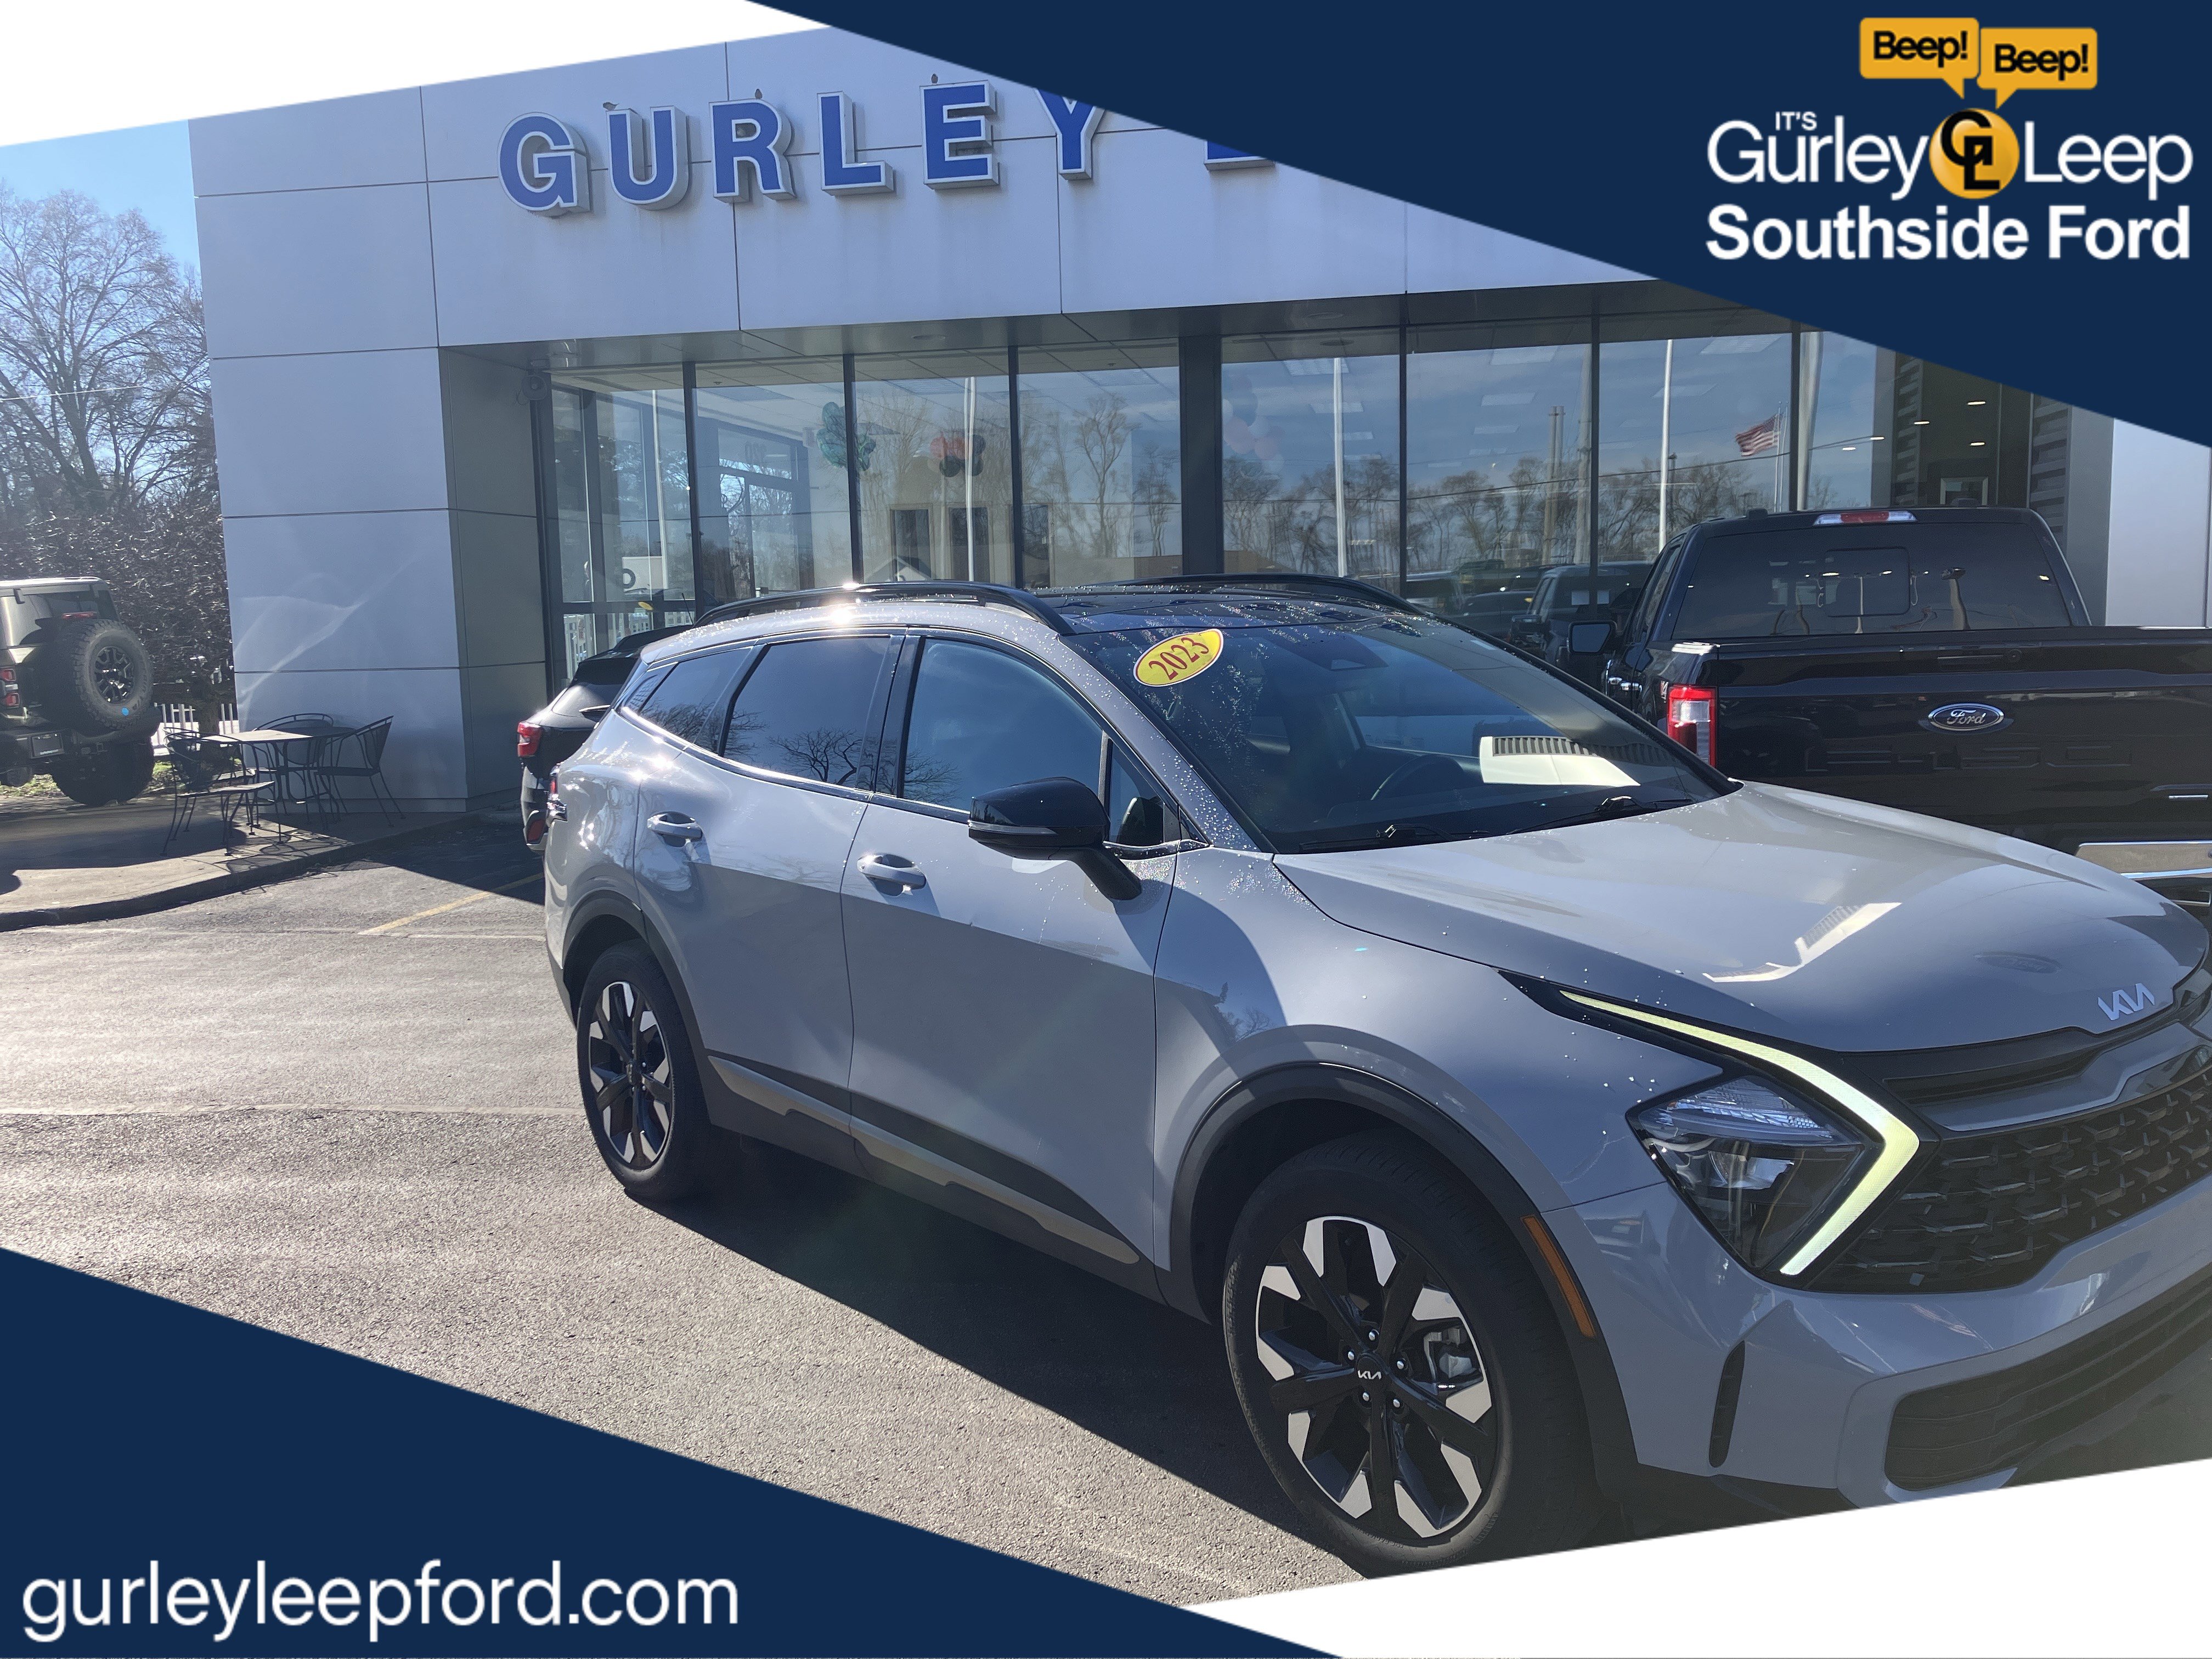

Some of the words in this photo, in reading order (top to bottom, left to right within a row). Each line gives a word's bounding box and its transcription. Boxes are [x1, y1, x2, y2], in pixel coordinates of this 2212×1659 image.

[498, 80, 1104, 214] GURLEY
[1148, 637, 1209, 680] 2023
[1946, 709, 1987, 725] Ford
[2097, 983, 2155, 1021] KIA
[1357, 1370, 1382, 1380] KIA
